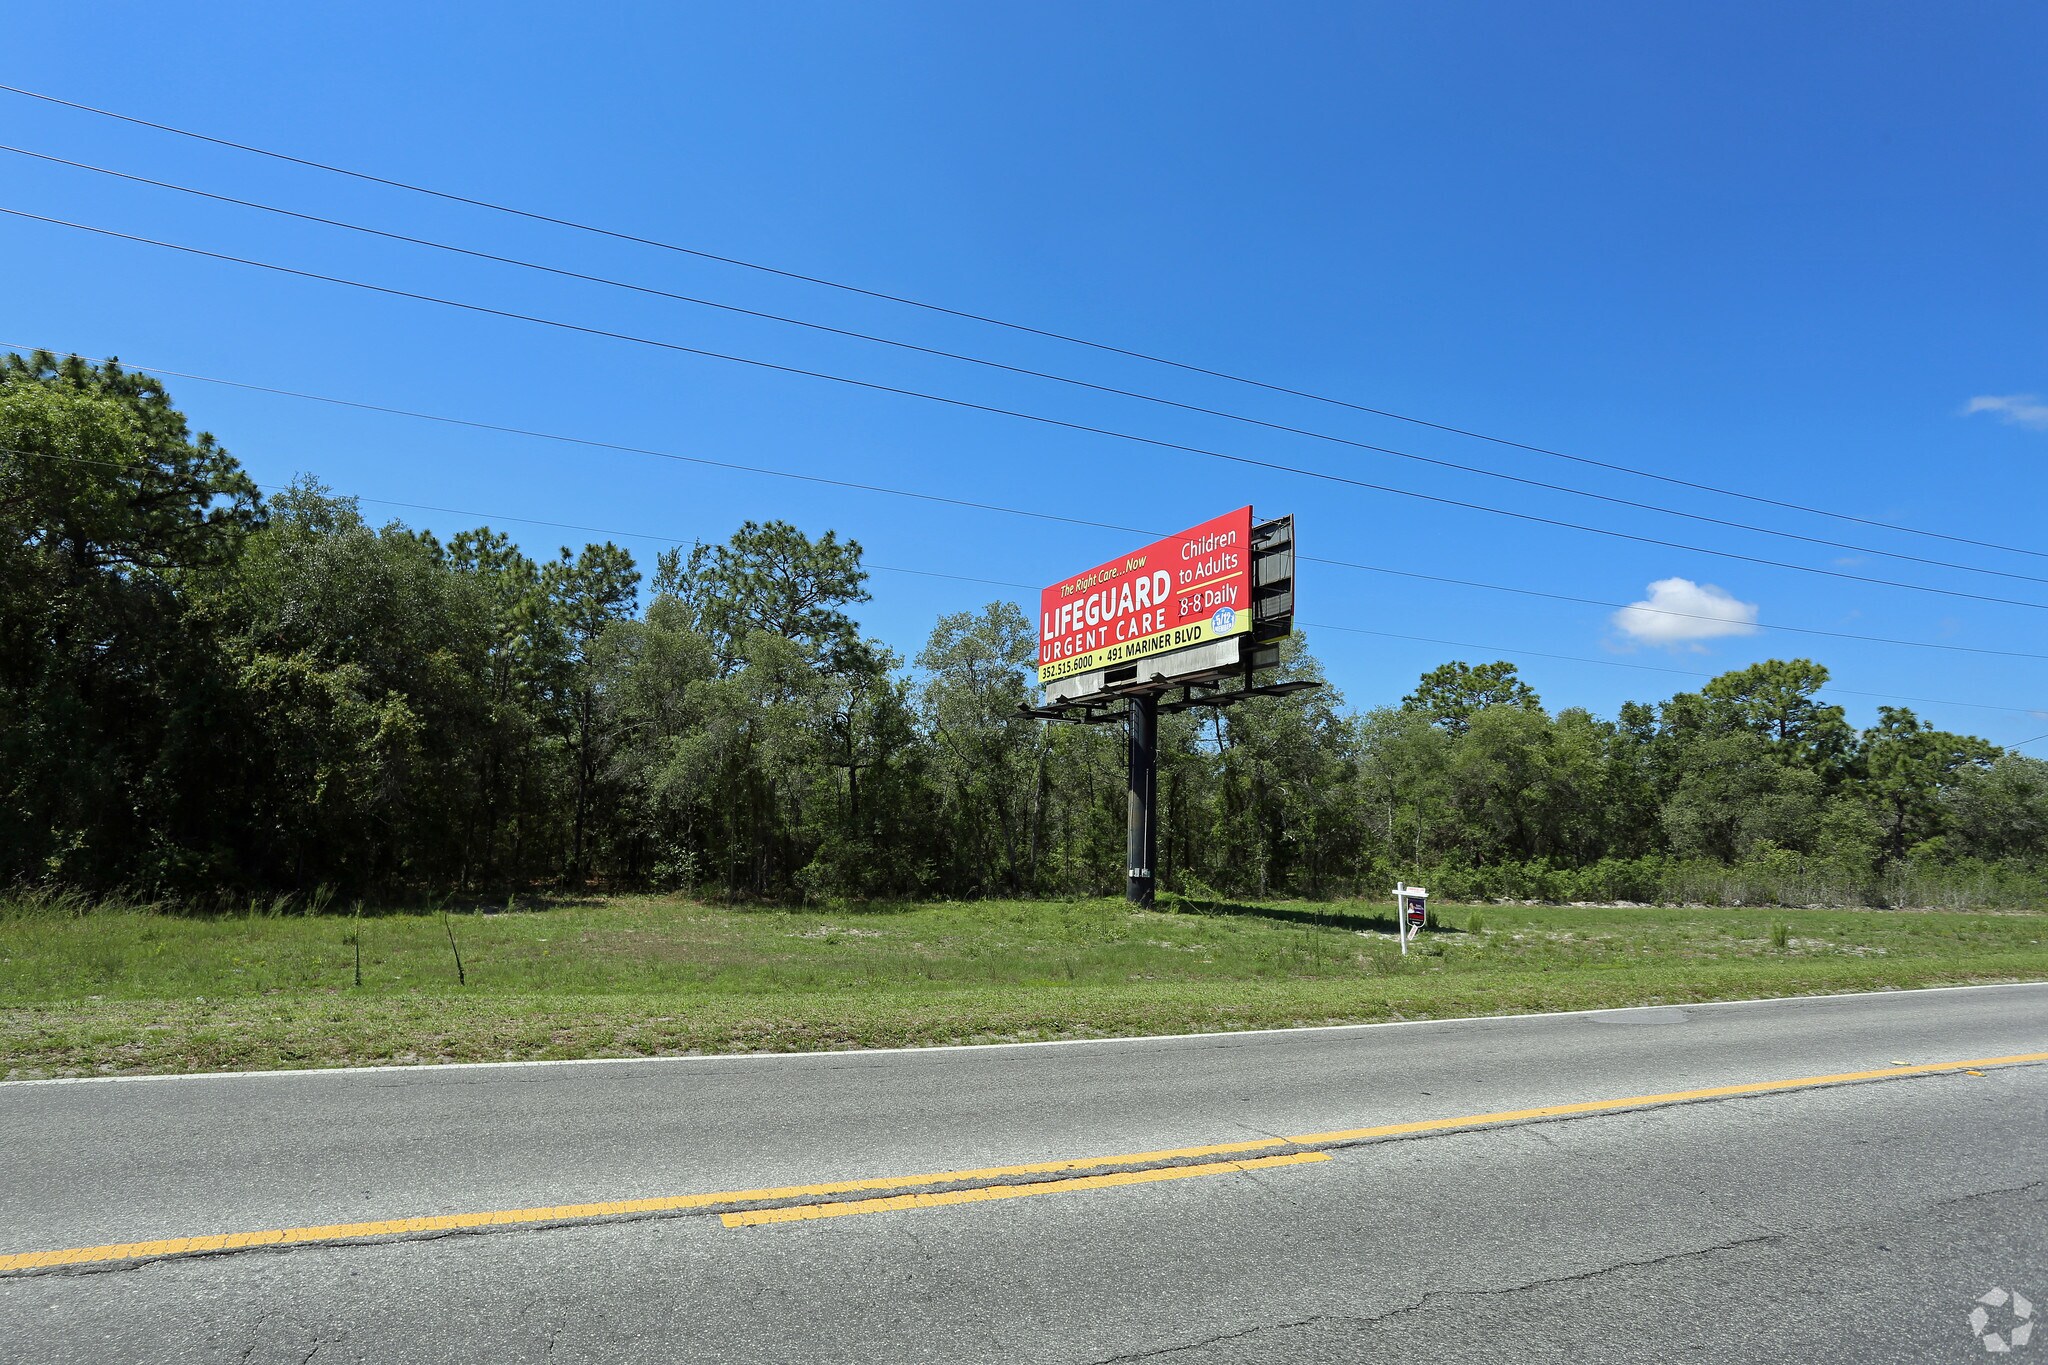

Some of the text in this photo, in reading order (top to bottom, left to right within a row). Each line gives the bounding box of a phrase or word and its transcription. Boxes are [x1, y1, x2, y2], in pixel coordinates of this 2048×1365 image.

[1181, 530, 1236, 560] Children
[1179, 552, 1238, 585] to Adults
[1060, 584, 1074, 599] The
[1075, 574, 1097, 594] Right
[1180, 583, 1238, 616] 8-8 Daily
[1043, 569, 1171, 642] LIFEGUARD
[1043, 608, 1166, 662] URGENT CARE
[1042, 626, 1202, 679] 352.515.6000 491 MARINER BLVD
